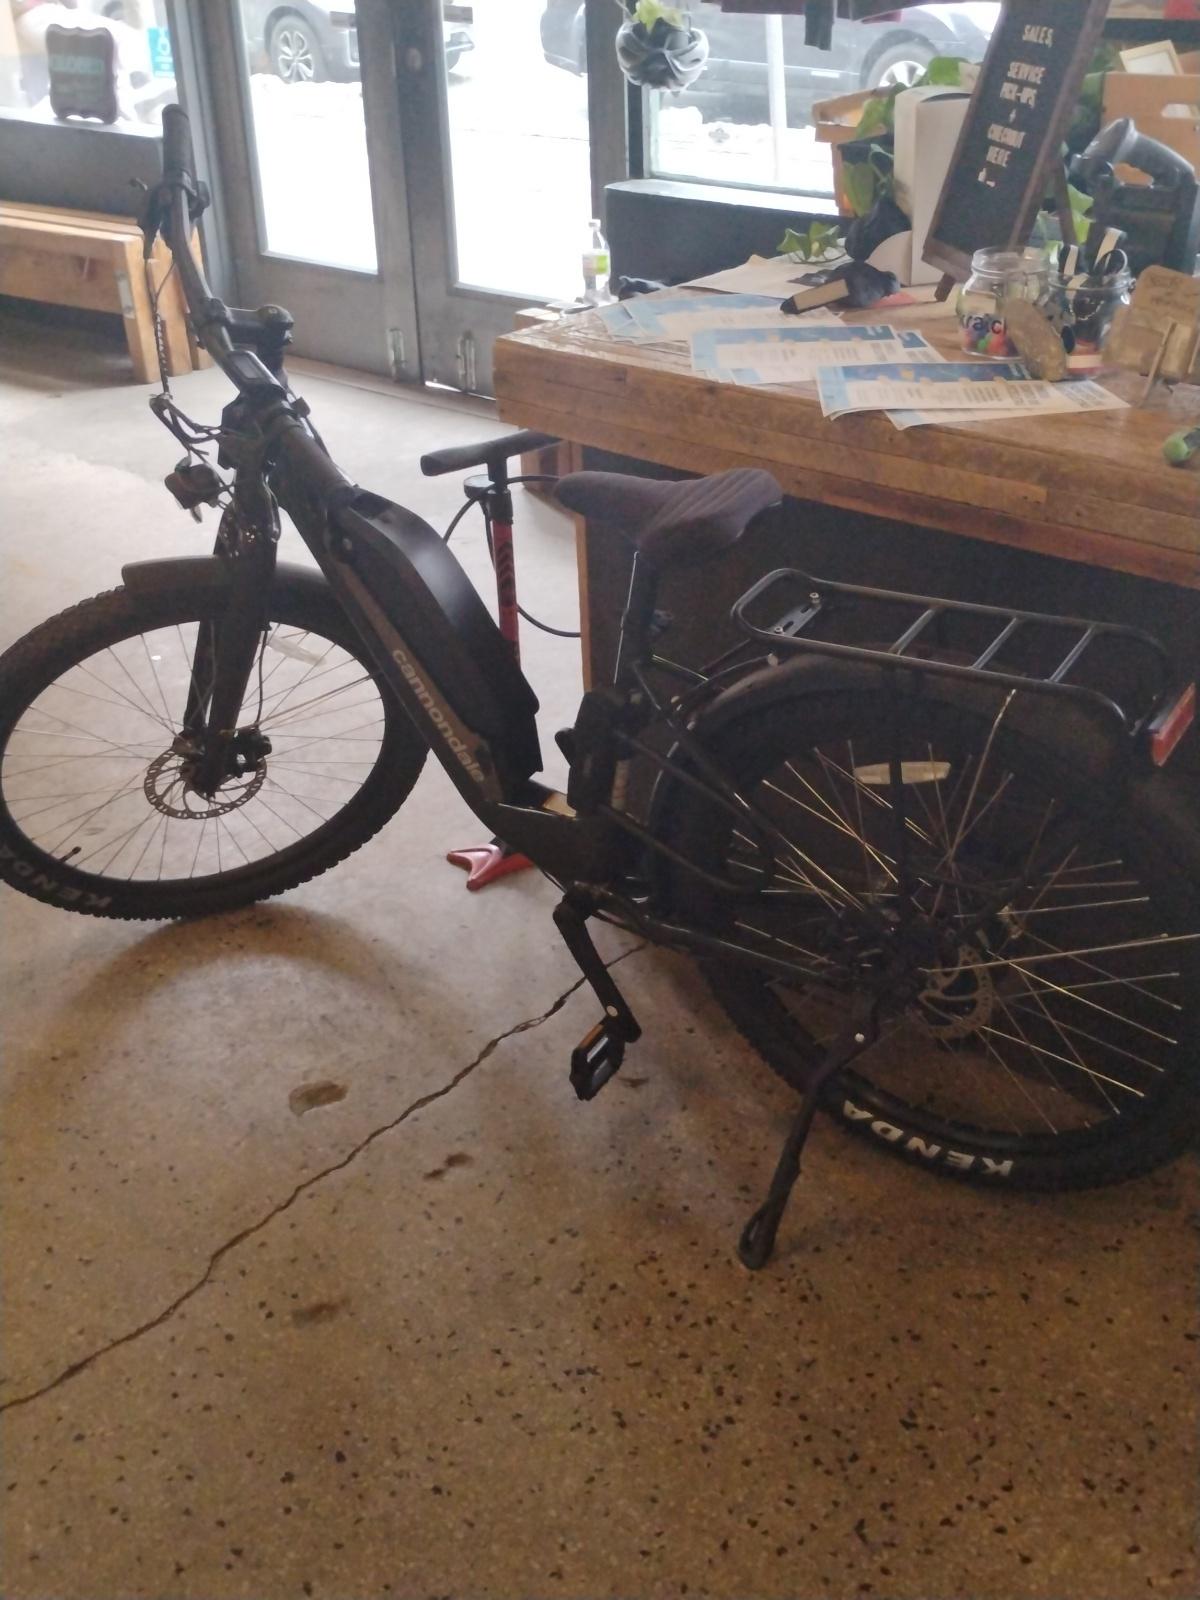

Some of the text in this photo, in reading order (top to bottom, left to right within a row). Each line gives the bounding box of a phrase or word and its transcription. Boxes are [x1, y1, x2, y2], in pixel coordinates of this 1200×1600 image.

[986, 146, 1011, 168] HERE
[392, 650, 485, 783] cannondale
[843, 1100, 1014, 1177] KENDA
